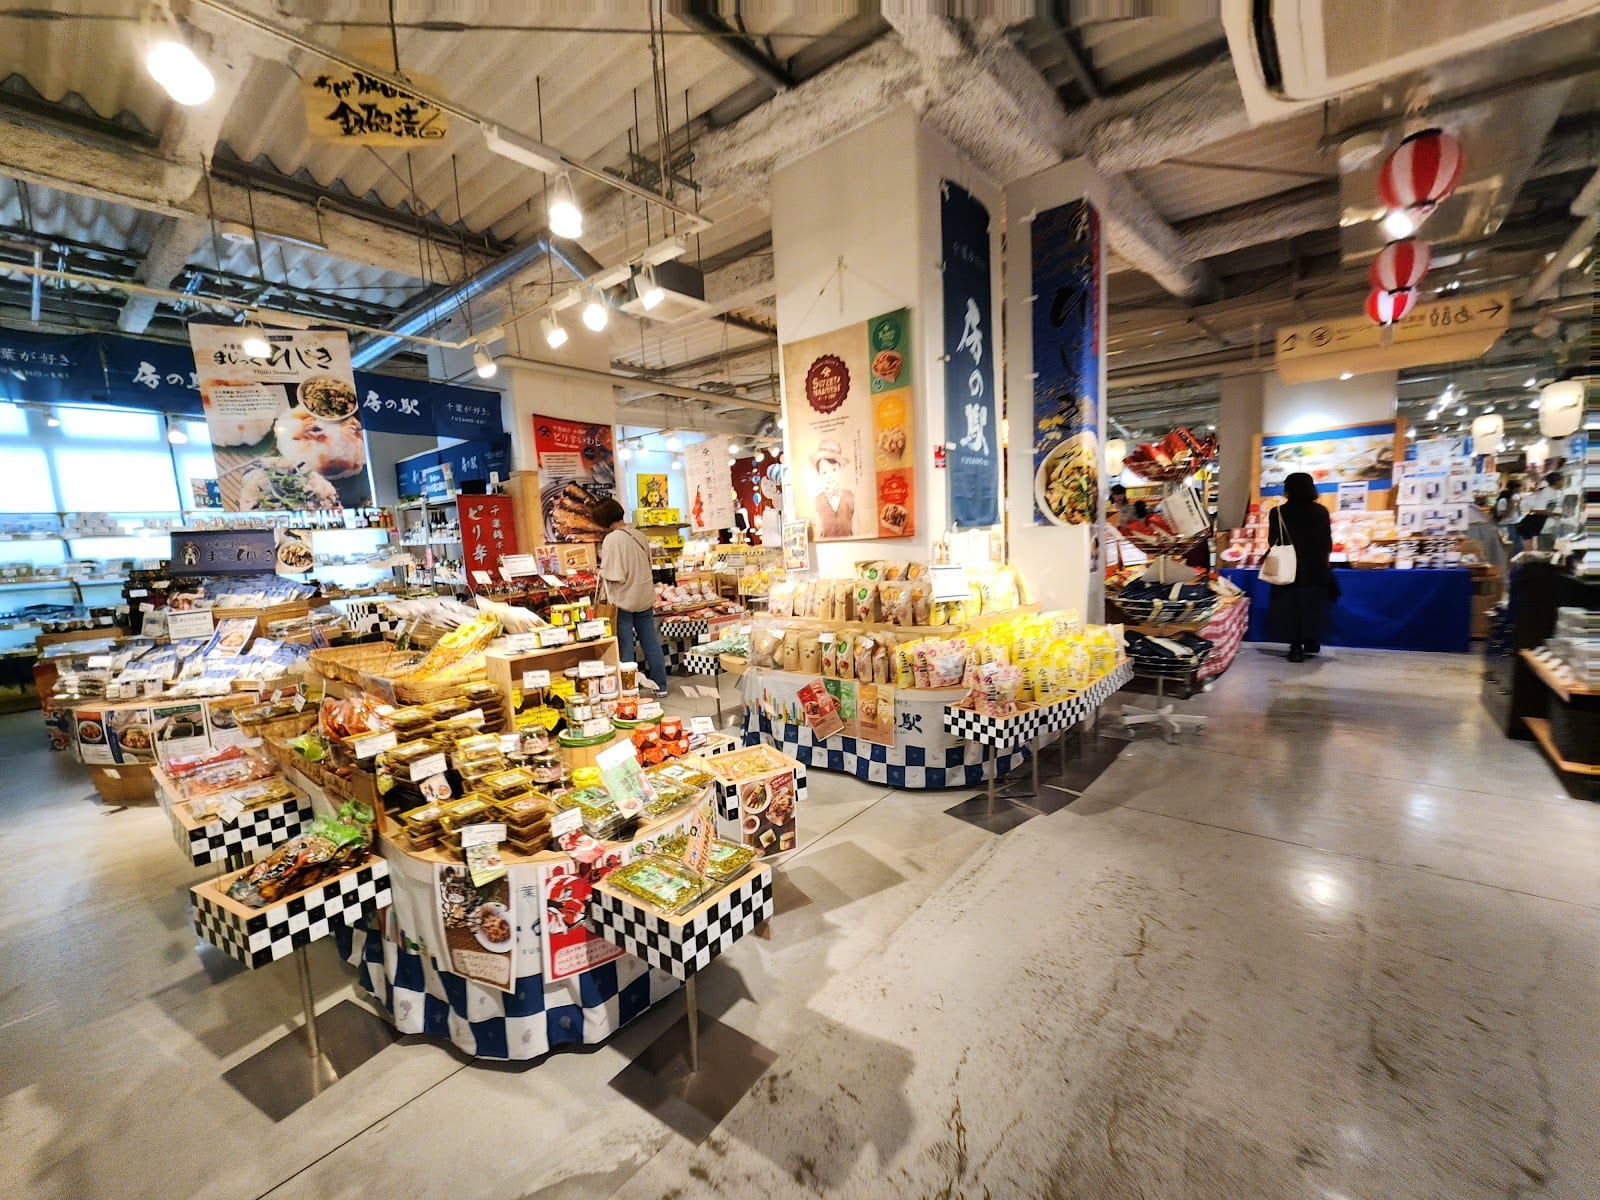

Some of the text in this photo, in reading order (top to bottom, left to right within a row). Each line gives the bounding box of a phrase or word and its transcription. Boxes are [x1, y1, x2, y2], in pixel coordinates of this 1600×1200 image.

[363, 390, 421, 417] 房の駅
[956, 297, 989, 456] 房の駅
[468, 504, 488, 565] ピリ辛
